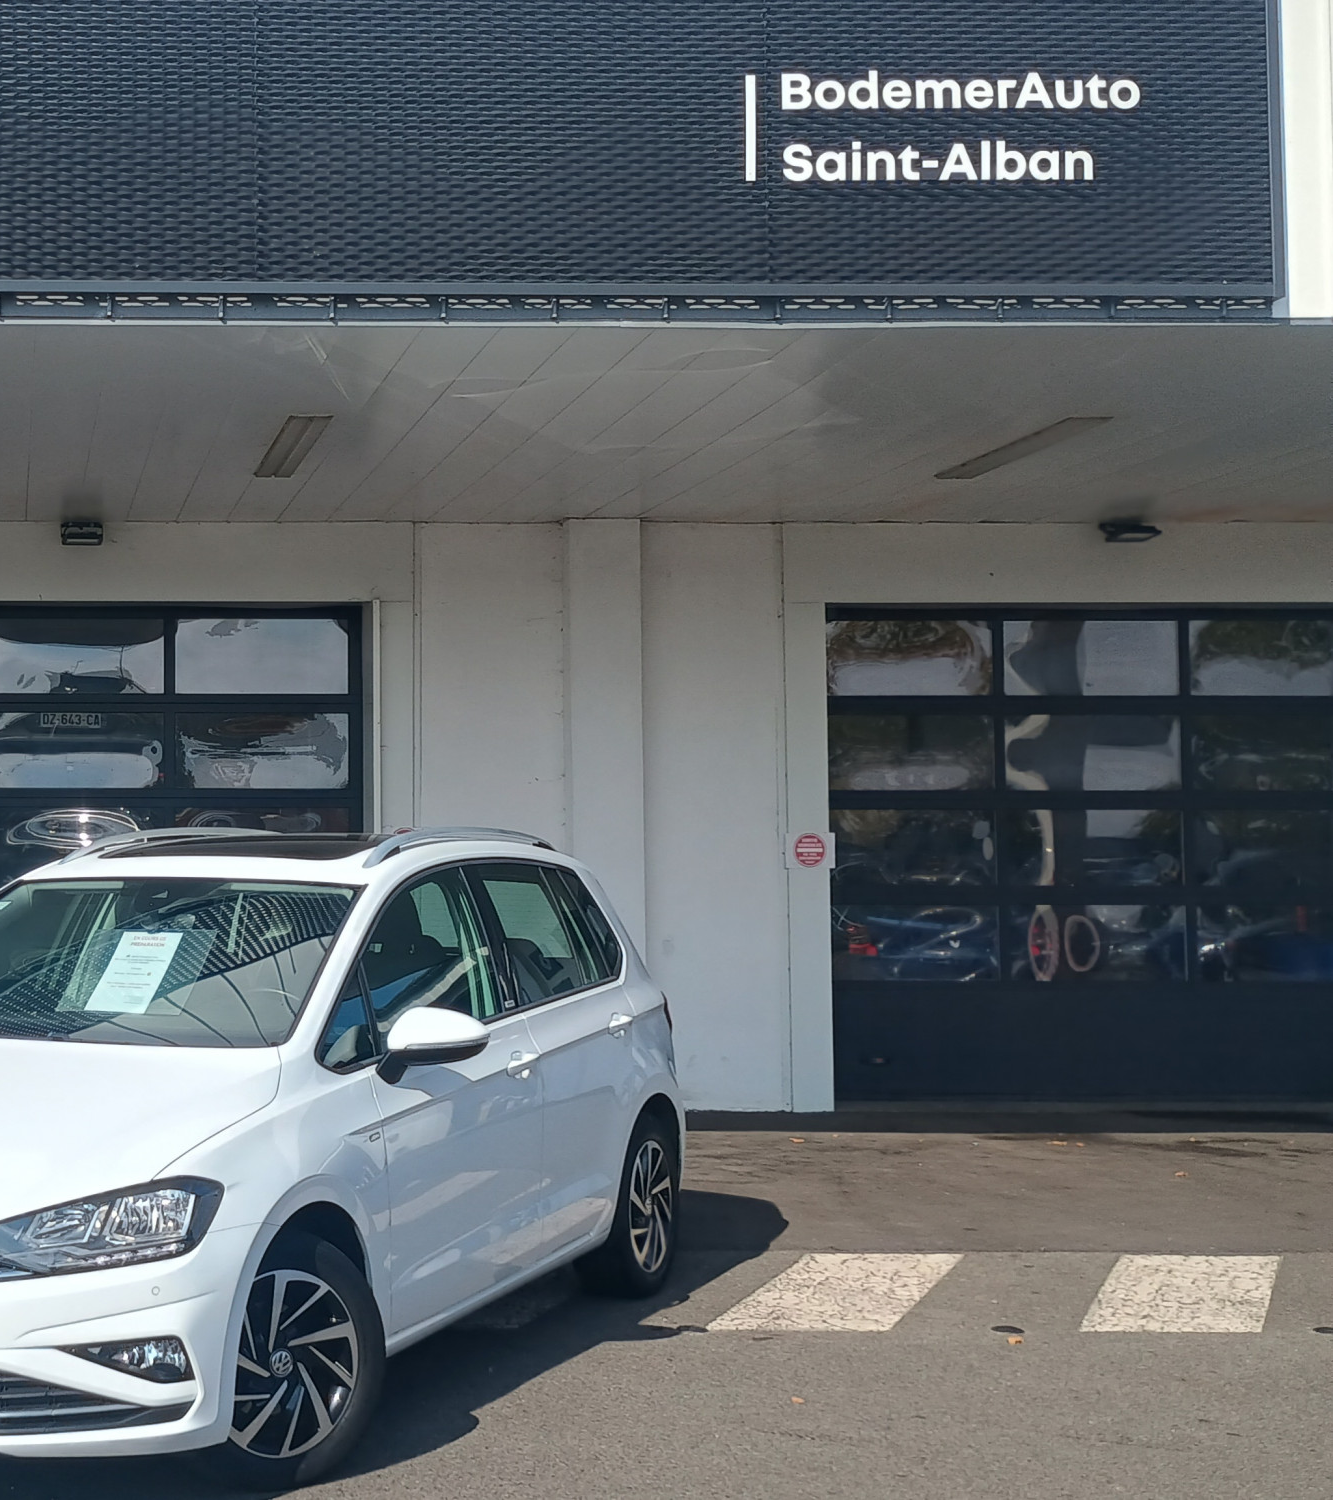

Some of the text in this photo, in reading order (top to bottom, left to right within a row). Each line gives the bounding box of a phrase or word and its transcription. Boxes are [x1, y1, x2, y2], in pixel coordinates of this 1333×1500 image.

[780, 70, 1141, 111] BodemerAuto
[782, 140, 1094, 183] Saint-Alban
[42, 713, 100, 726] DZ-643-CA
